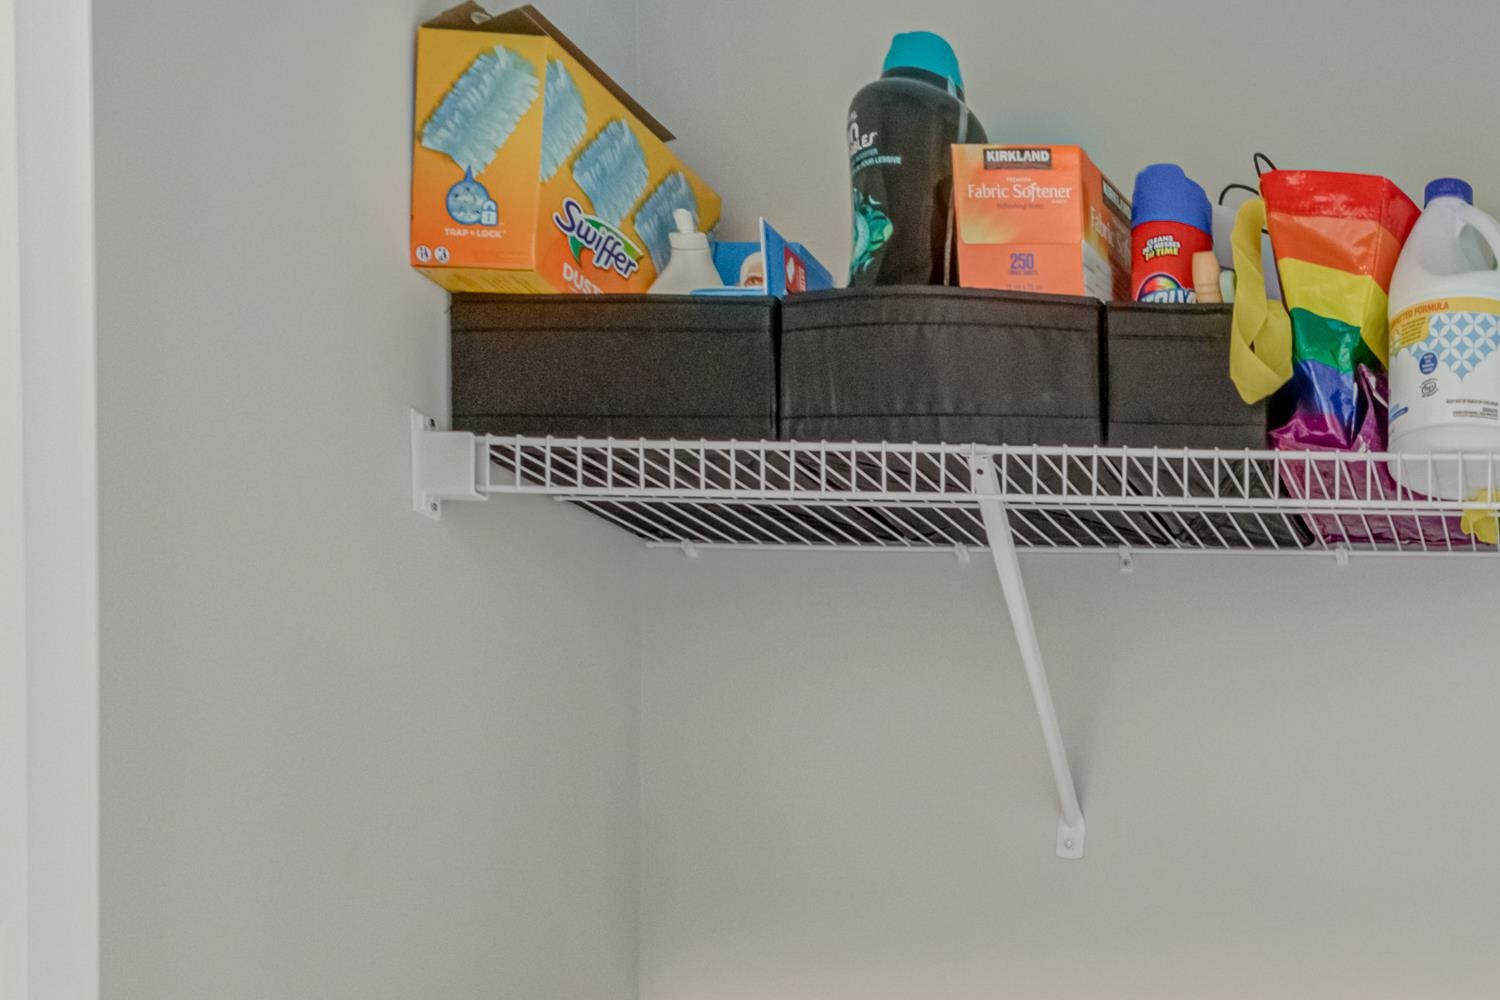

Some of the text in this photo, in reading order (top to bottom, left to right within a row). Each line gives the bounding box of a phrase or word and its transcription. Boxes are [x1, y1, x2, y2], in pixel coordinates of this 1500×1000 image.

[985, 149, 1051, 163] KIRKLAND
[967, 181, 1073, 202] Fabric Softener
[444, 228, 469, 238] TRAP
[476, 230, 503, 239] LOCK
[553, 198, 638, 277] Swiffer
[1010, 252, 1035, 271] 250
